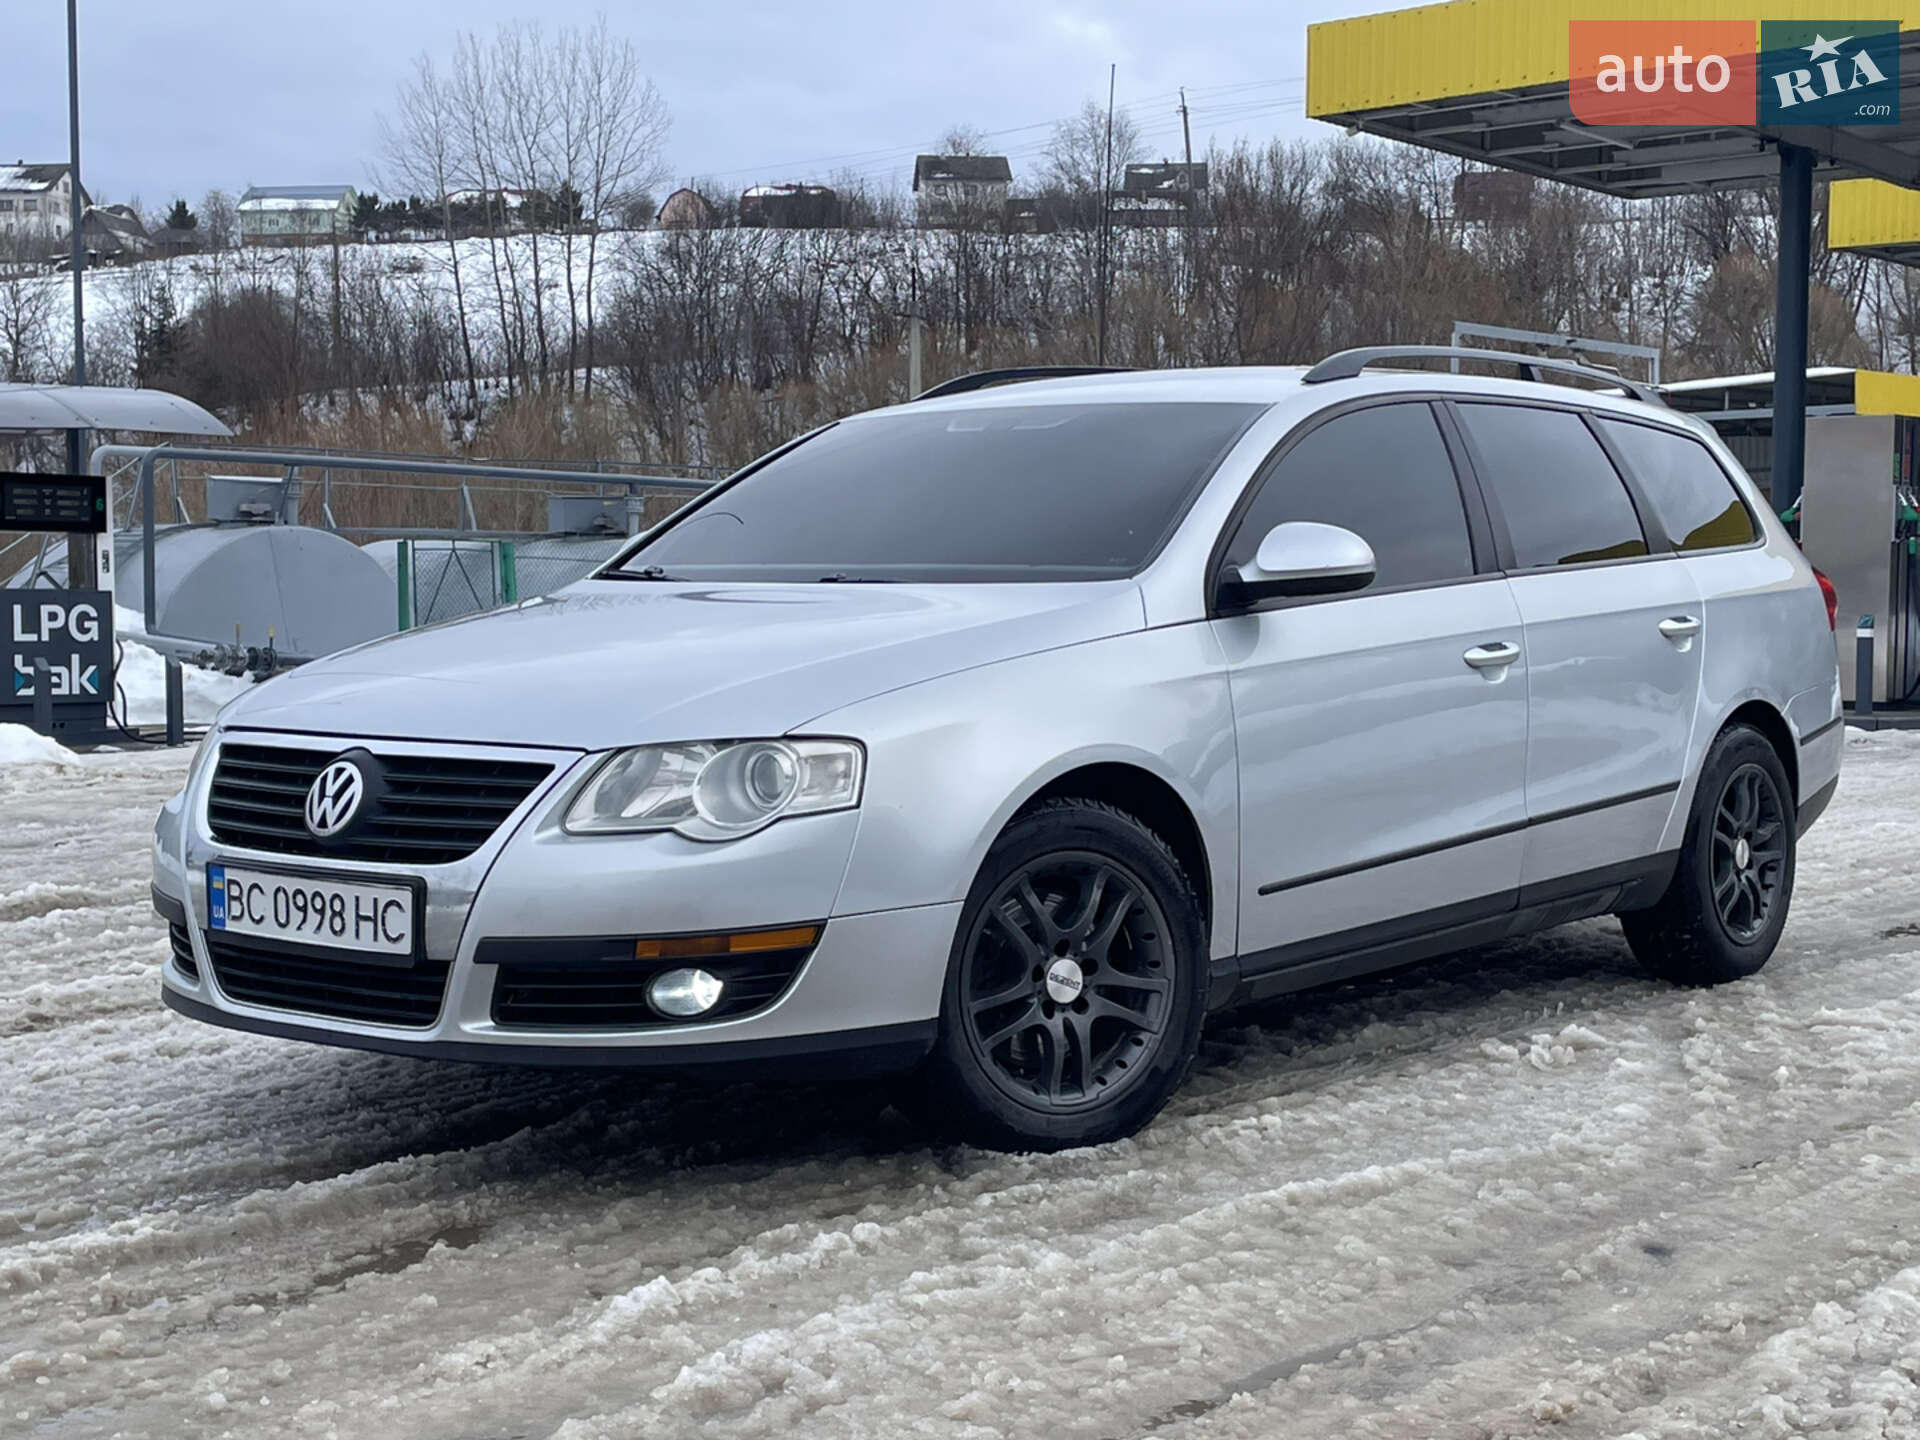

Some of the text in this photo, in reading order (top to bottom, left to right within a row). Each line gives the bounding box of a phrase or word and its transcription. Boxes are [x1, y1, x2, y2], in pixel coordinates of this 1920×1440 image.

[12, 603, 99, 642] LPG
[227, 878, 406, 943] BC 0998 HC
